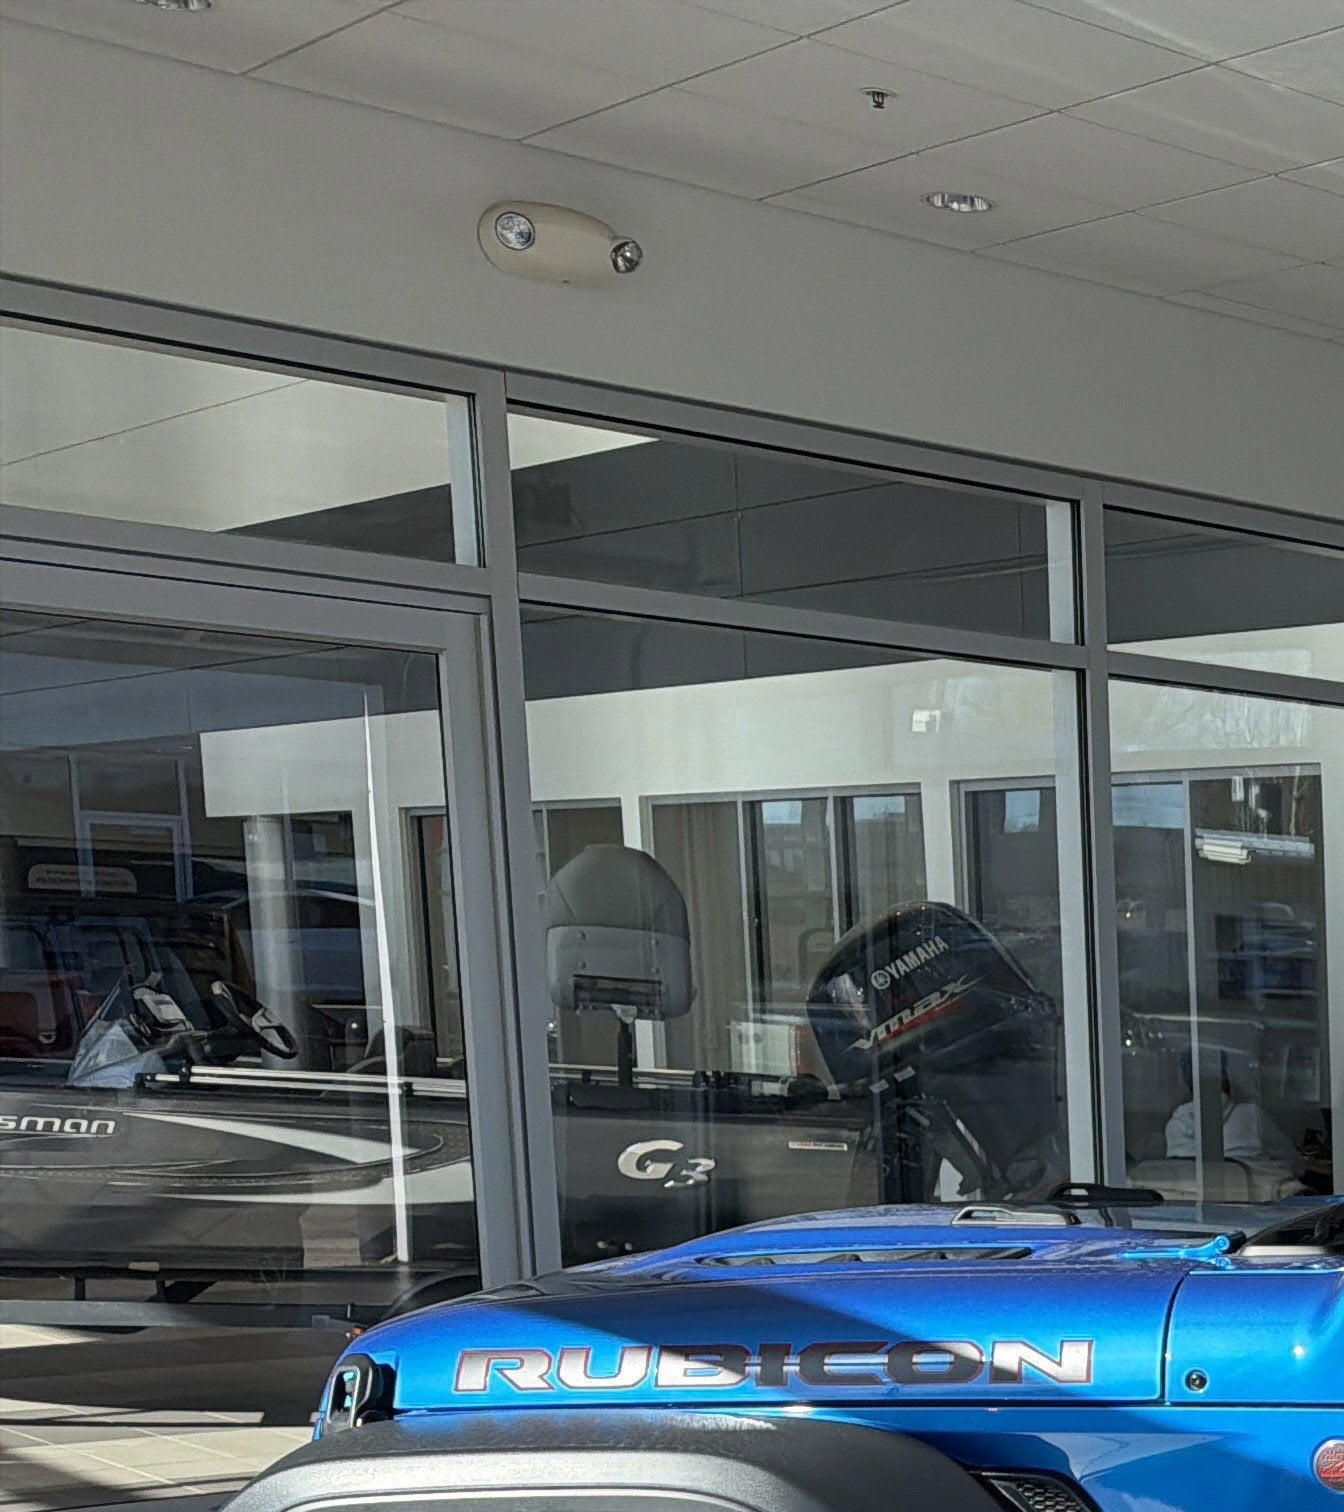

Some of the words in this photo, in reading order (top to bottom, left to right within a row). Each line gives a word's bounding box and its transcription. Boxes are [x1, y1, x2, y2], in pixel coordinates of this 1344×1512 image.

[884, 935, 950, 981] YAMAHA
[617, 1139, 716, 1188] G3
[453, 1339, 1093, 1391] RUBICON
